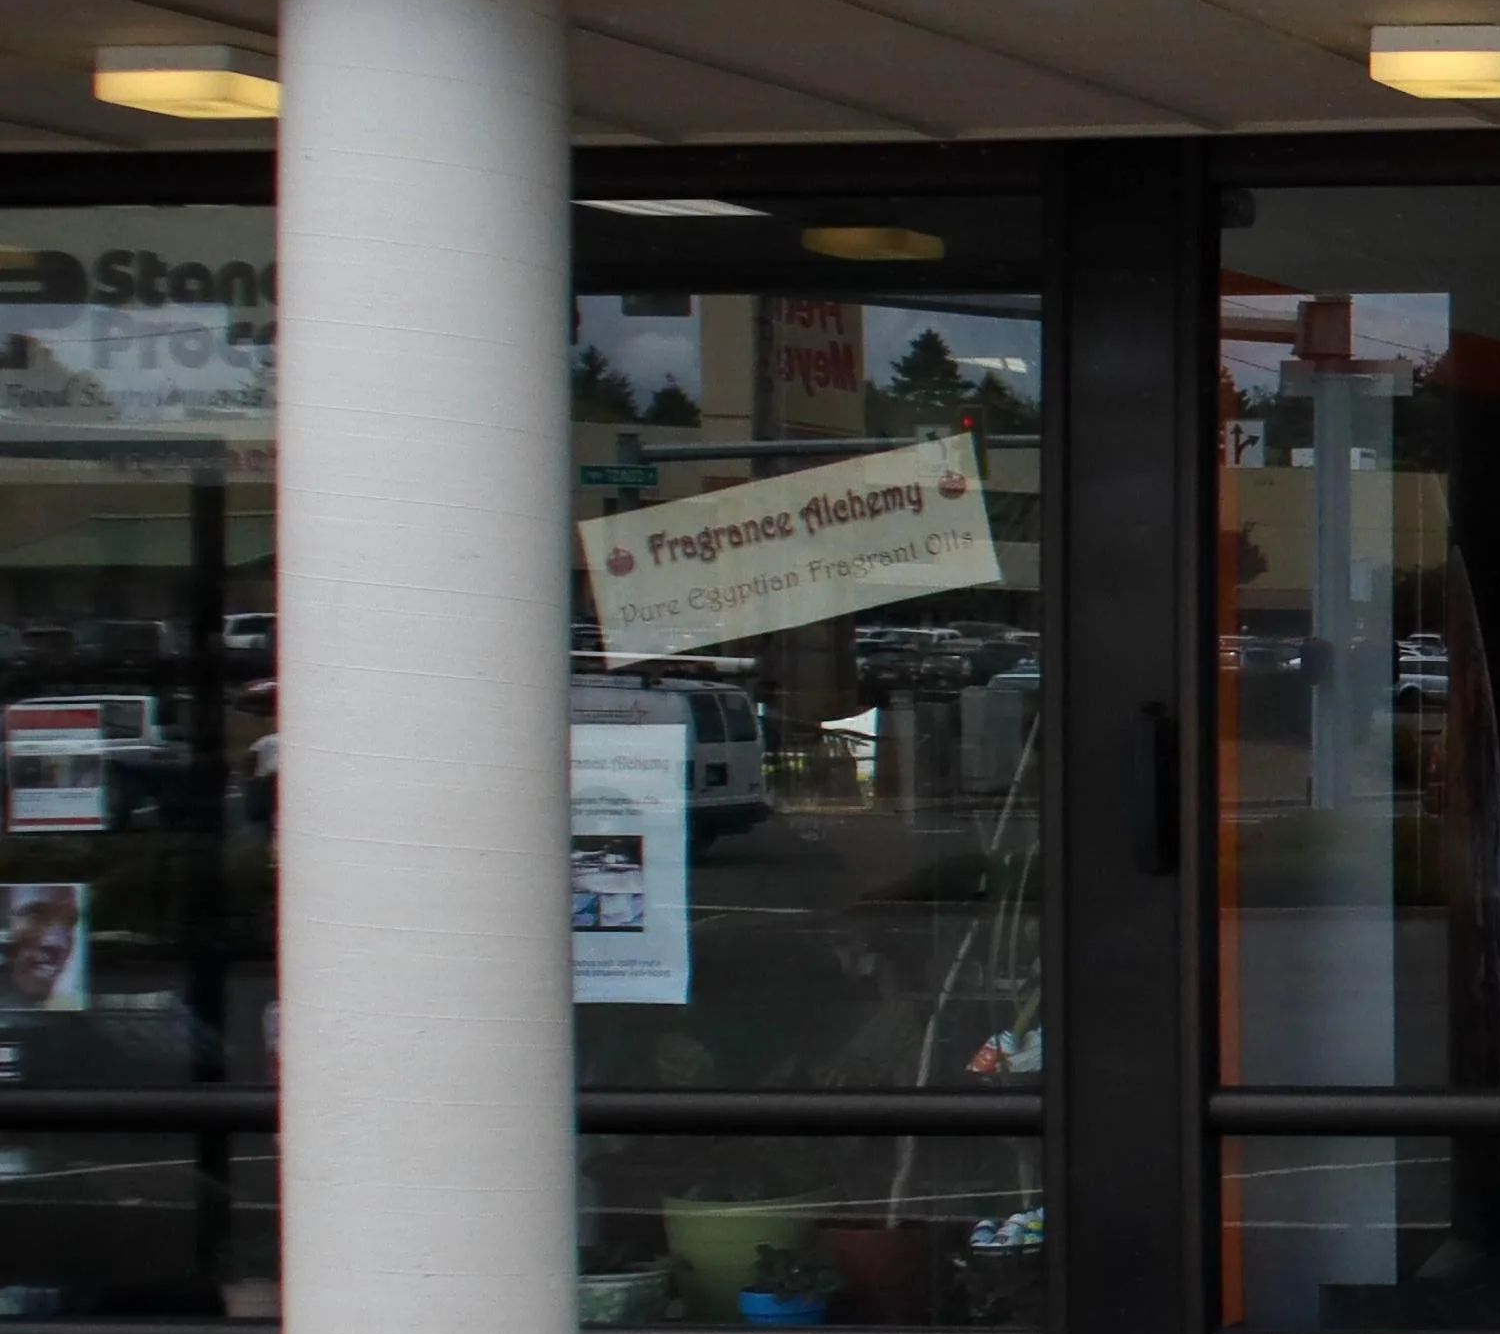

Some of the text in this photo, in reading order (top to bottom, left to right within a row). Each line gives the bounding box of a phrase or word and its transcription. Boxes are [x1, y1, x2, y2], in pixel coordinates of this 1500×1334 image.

[648, 483, 924, 565] Fragrance Alchemy
[620, 530, 973, 627] Pure Egyptian Fragrant Oils
